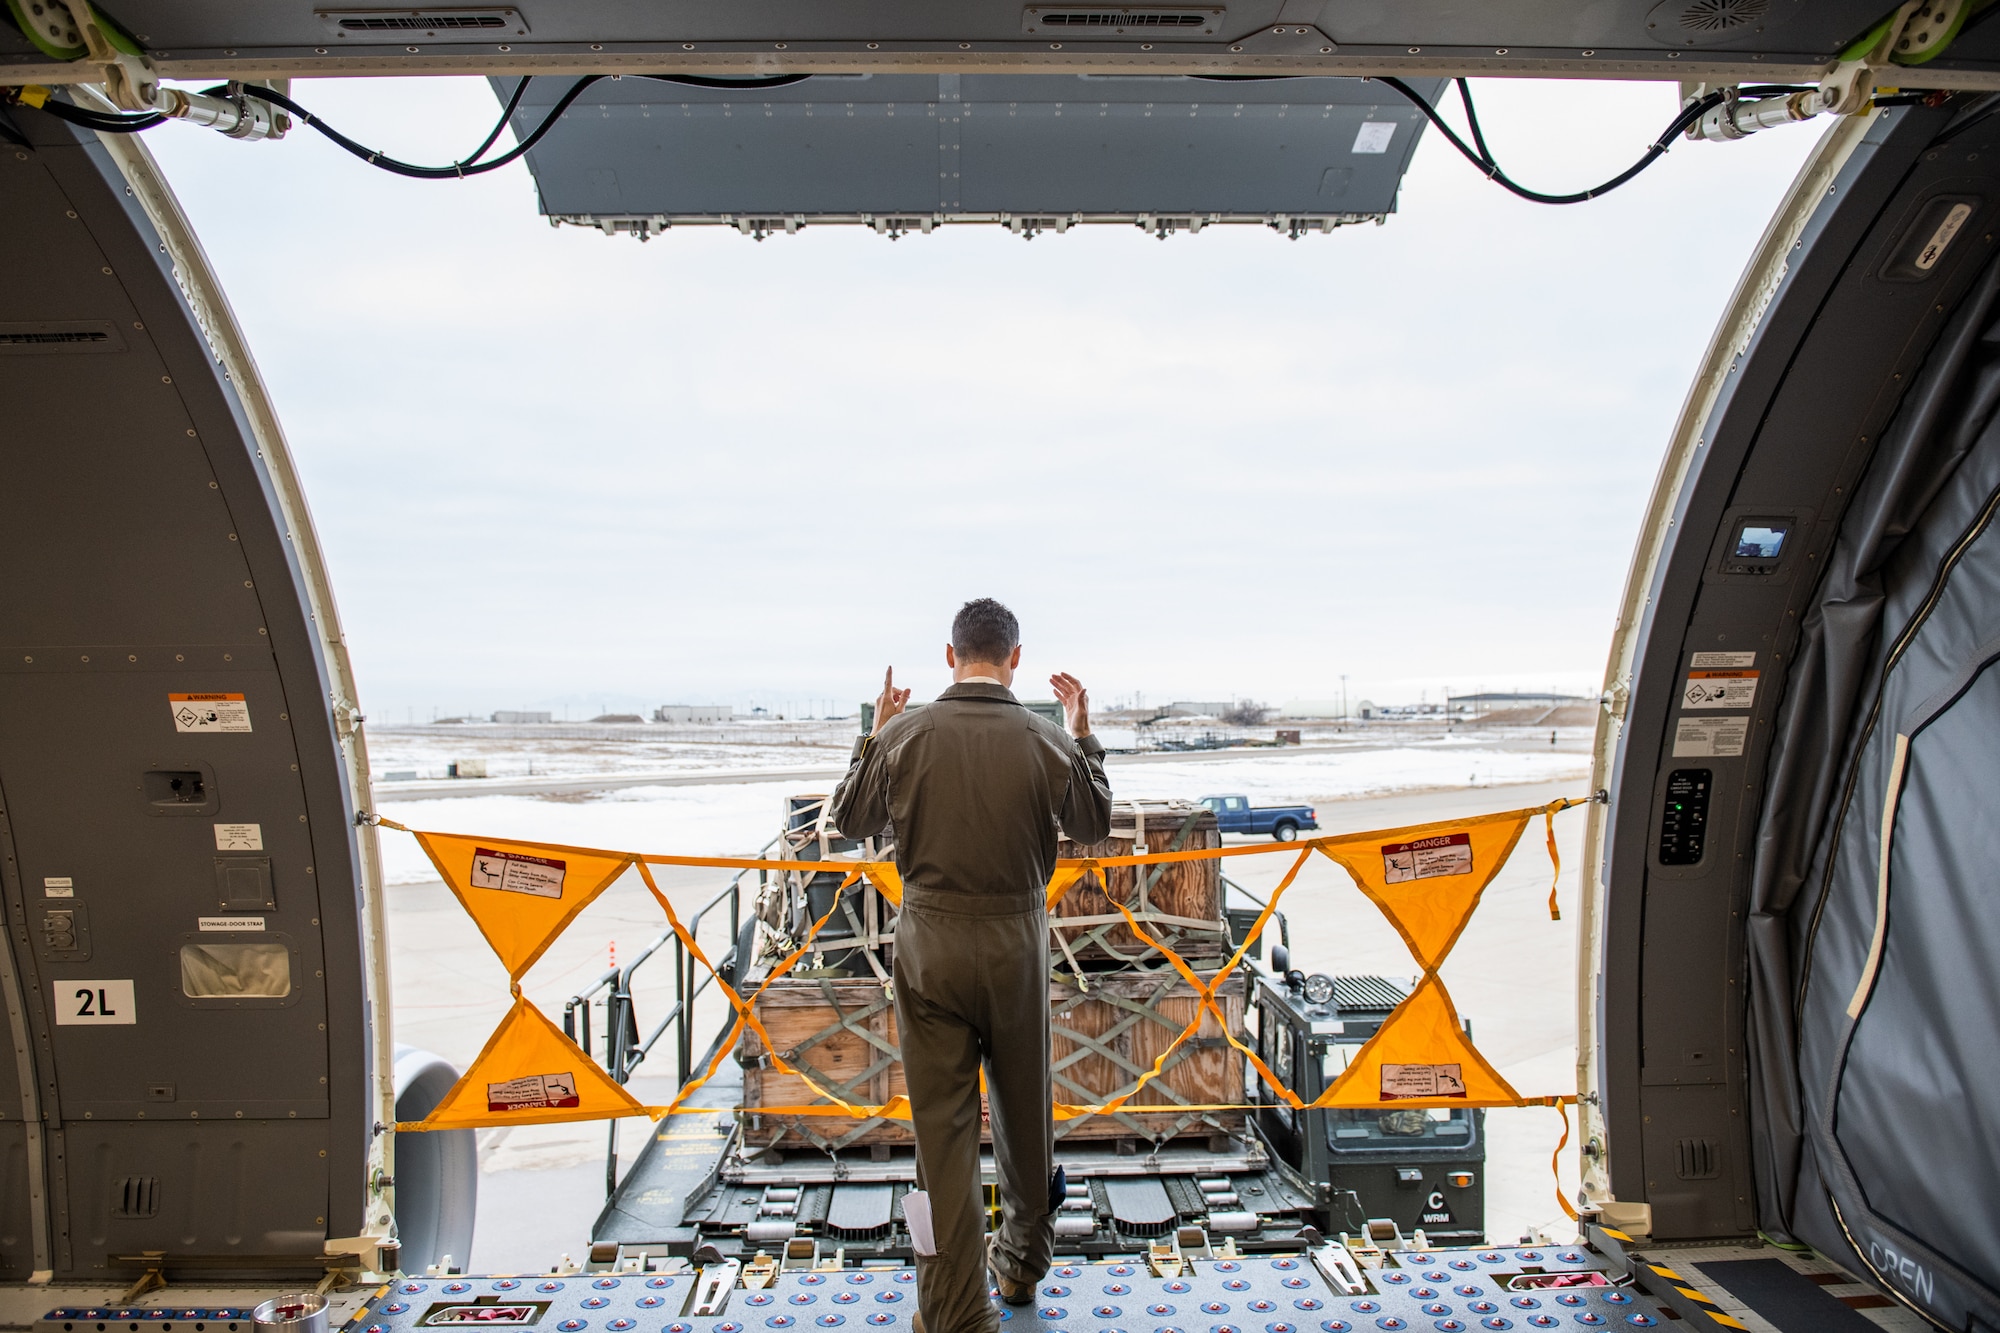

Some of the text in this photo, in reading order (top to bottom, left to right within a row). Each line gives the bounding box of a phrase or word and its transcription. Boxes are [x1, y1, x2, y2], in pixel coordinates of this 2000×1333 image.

[1412, 836, 1451, 850] DANGER
[507, 853, 548, 864] DANGER
[76, 988, 116, 1016] 2L
[507, 1100, 546, 1110] DANGER
[1428, 1191, 1443, 1210] C
[1423, 1213, 1449, 1223] WRM
[1870, 1242, 1933, 1305] OPEN
